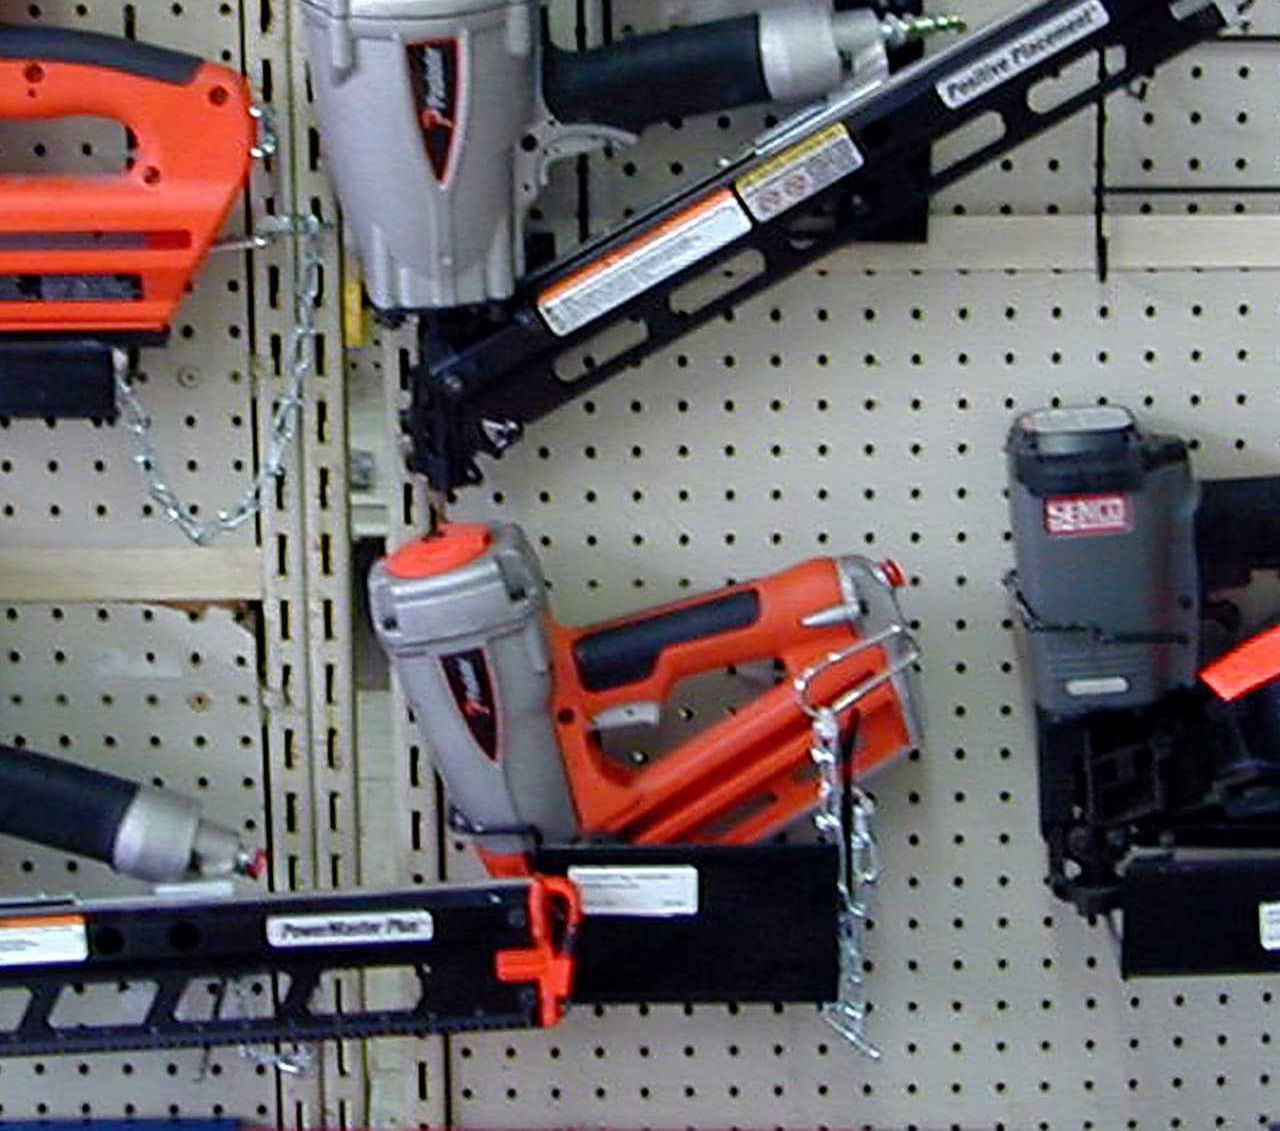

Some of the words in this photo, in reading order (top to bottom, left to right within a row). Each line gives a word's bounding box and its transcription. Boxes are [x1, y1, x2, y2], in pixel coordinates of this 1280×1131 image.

[946, 58, 1010, 101] Positive
[1047, 498, 1125, 525] SENCO
[281, 921, 383, 940] PowerMaster
